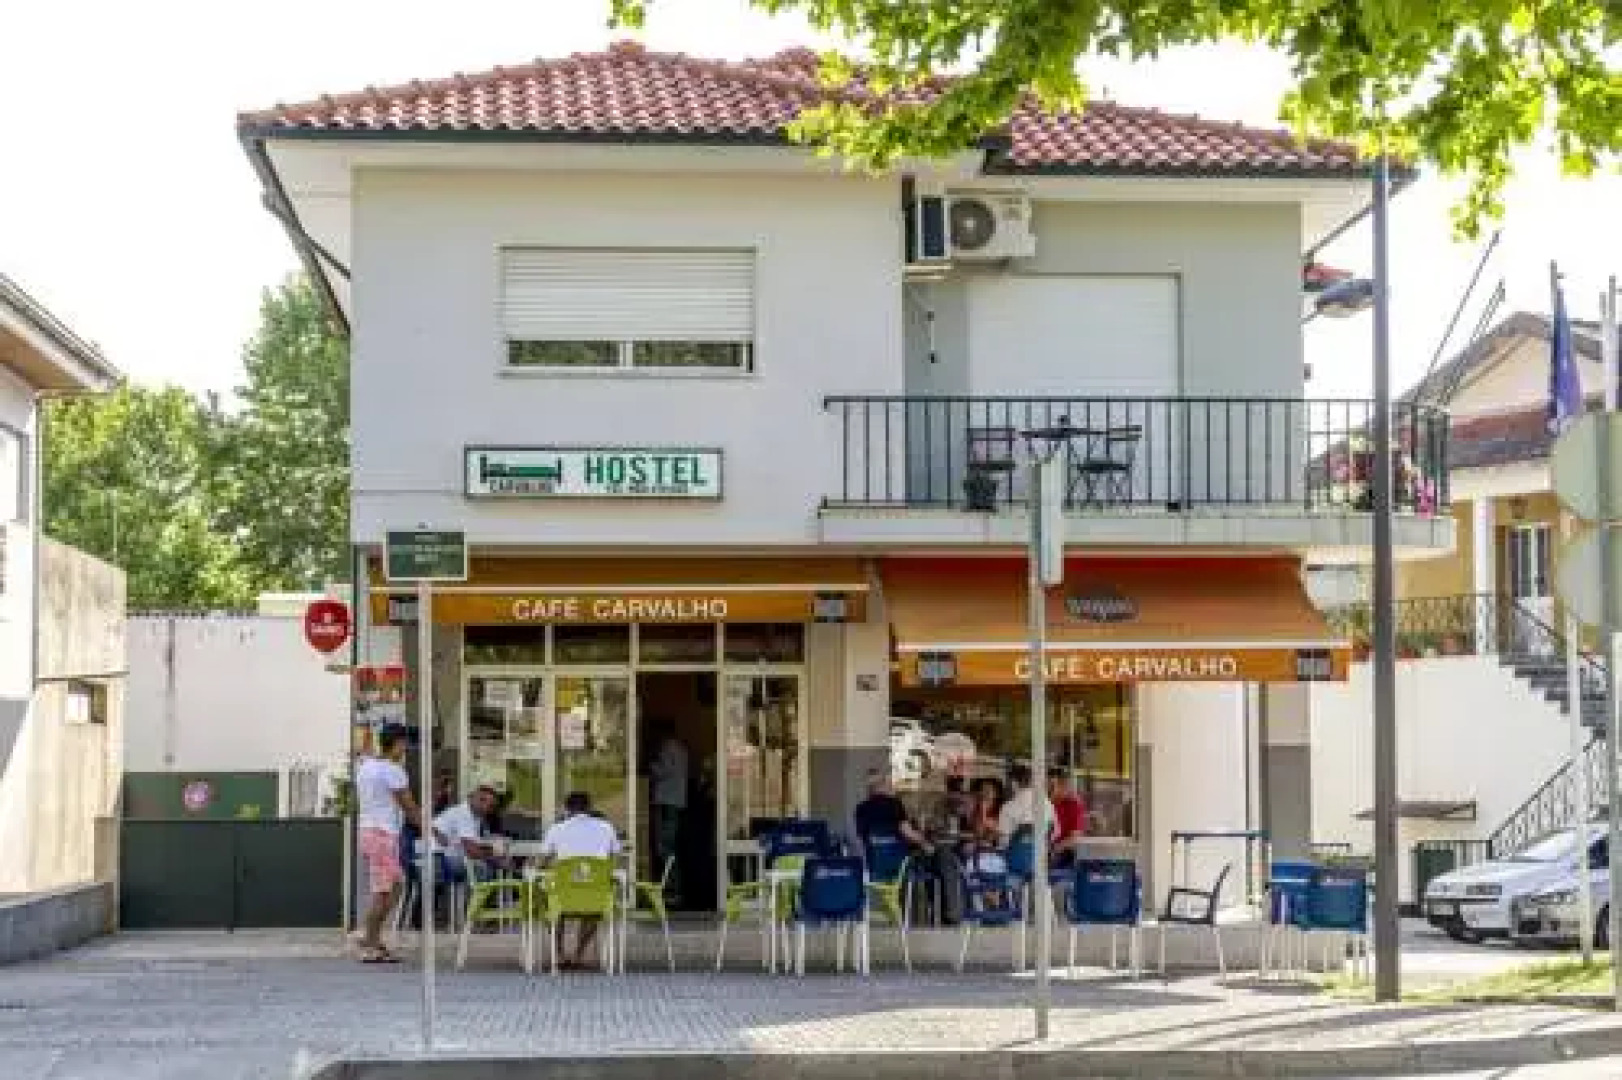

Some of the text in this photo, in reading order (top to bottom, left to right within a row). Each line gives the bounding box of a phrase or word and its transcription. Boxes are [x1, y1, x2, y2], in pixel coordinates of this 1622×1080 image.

[583, 455, 708, 486] HOSTEL
[593, 599, 728, 620] CARVALHO
[1098, 656, 1237, 678] CARVALHO
